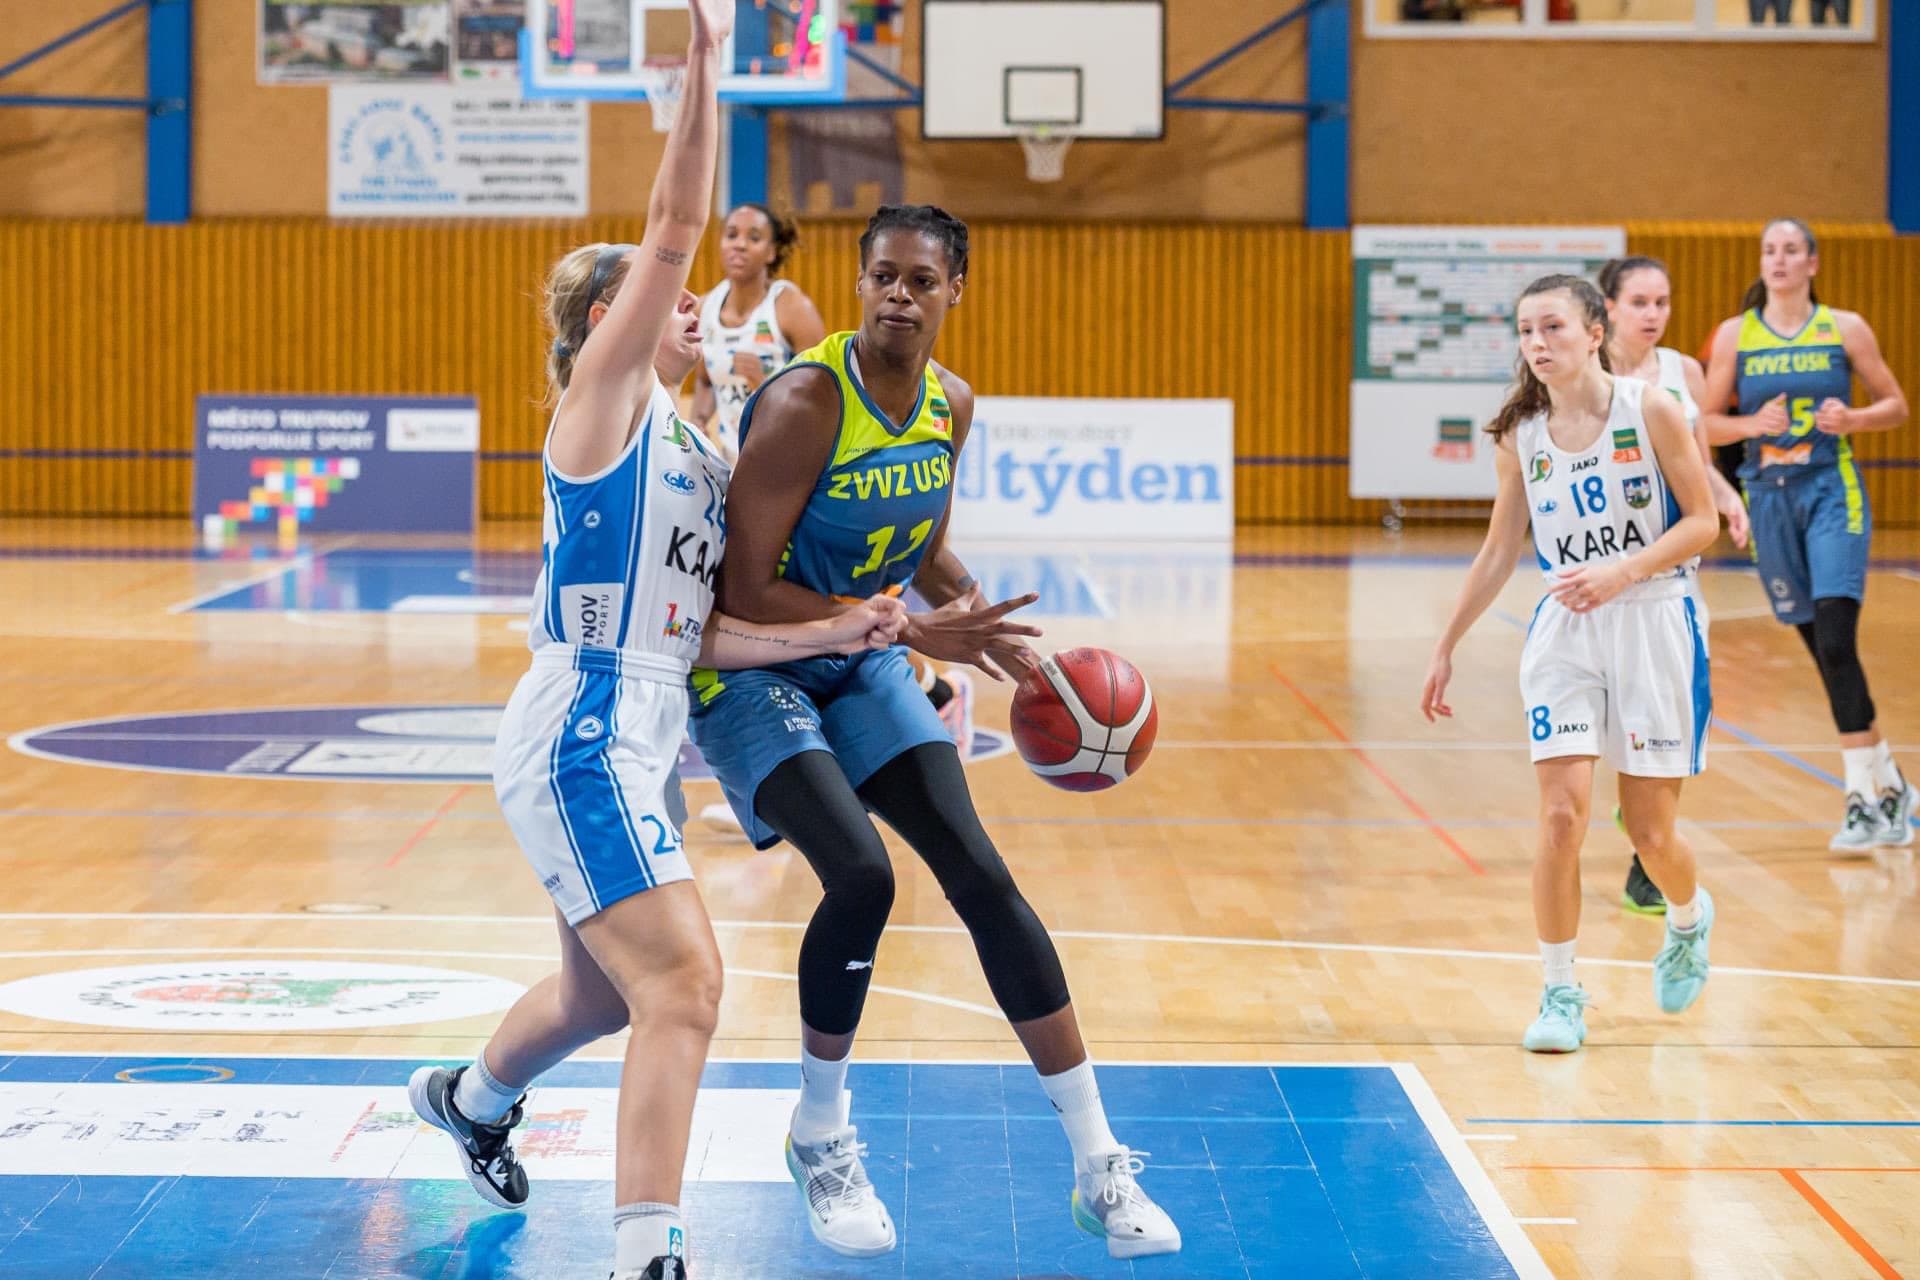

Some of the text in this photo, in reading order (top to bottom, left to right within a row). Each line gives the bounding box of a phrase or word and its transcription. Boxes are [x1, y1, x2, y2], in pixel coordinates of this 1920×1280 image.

[1789, 396, 1816, 437] 5
[827, 464, 912, 501] ZVVZ
[993, 447, 1223, 517] týden
[1570, 456, 1599, 473] JAKO
[1569, 475, 1607, 518] 18
[1556, 519, 1646, 565] KARA
[1556, 723, 1589, 735] JAKO
